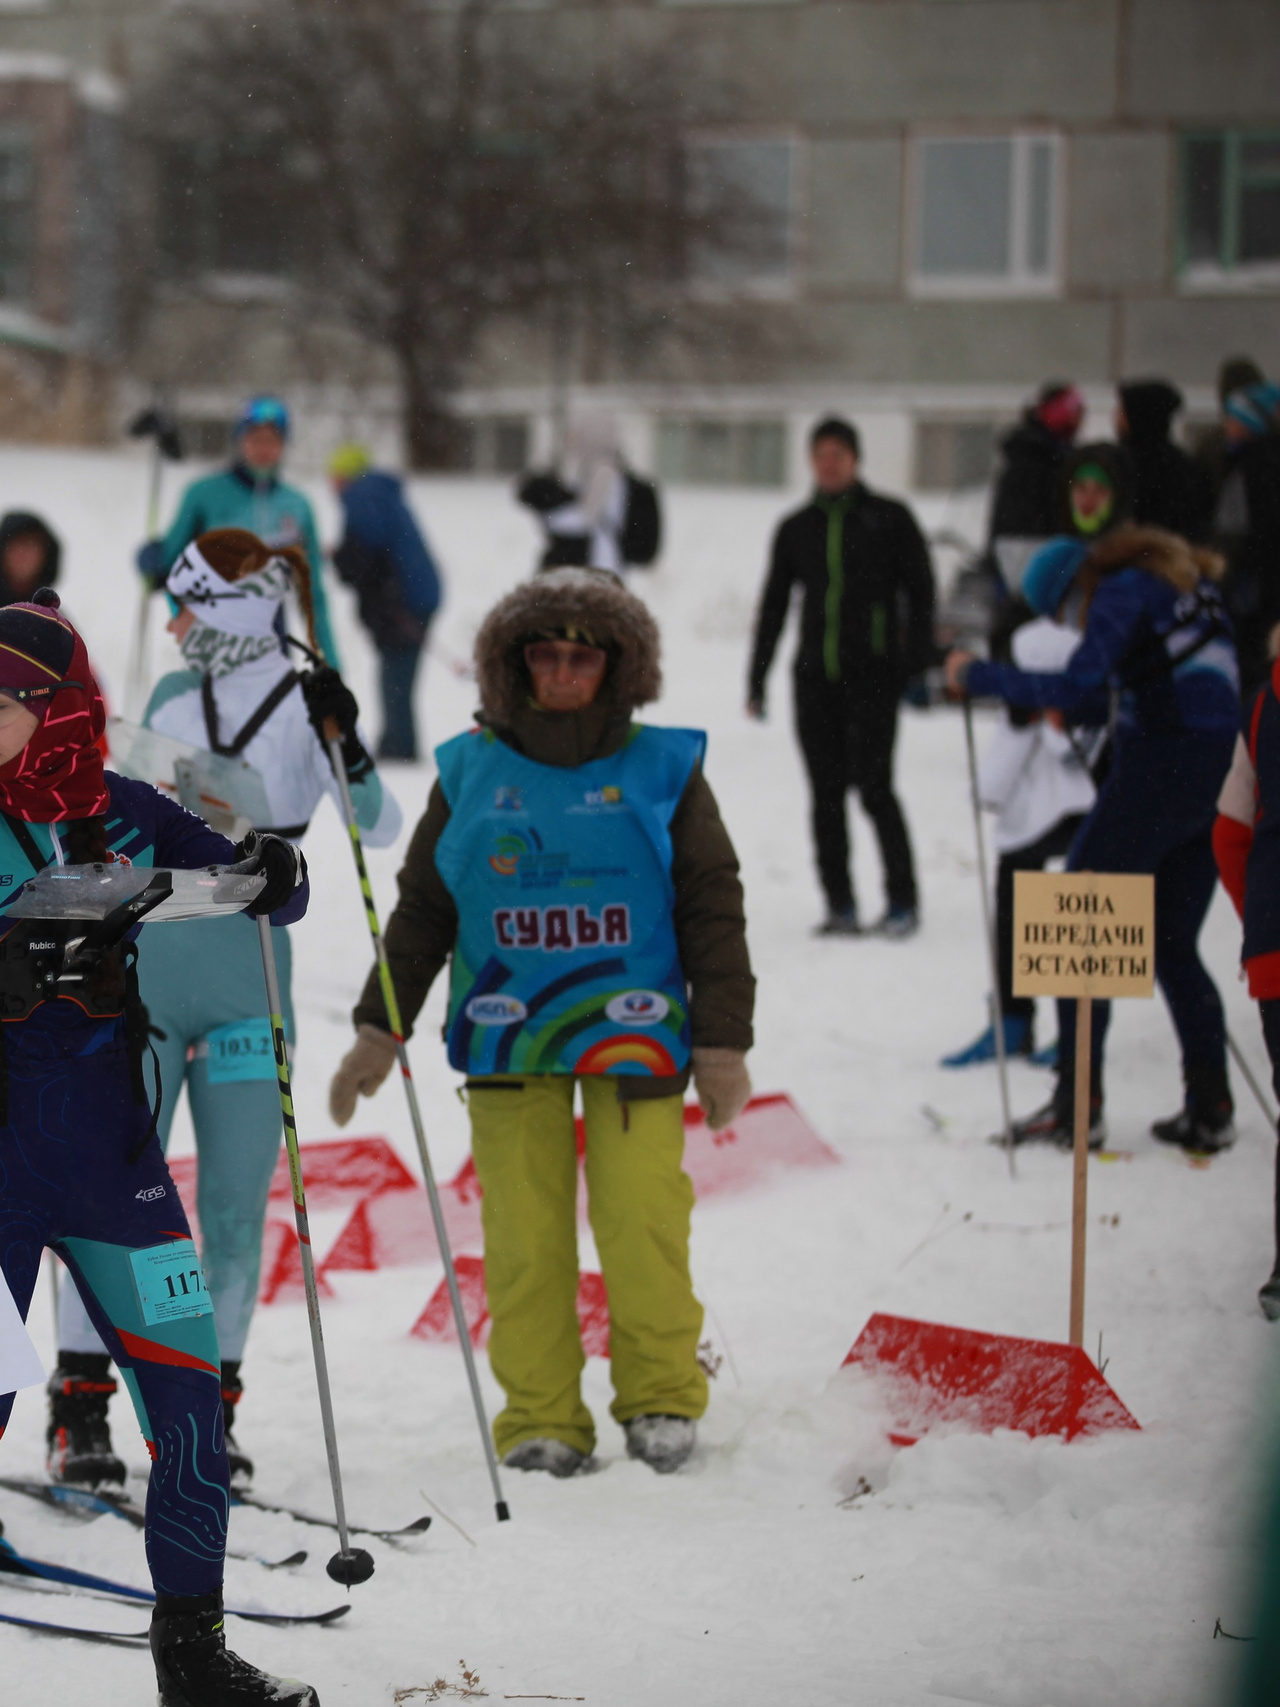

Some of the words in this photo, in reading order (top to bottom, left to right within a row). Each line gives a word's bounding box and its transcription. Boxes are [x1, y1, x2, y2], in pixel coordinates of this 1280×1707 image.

[1055, 892, 1115, 915] ЗОНА
[493, 905, 631, 950] СУДЬЯ
[1024, 923, 1145, 948] ПЕРЕДАЧИ
[1019, 953, 1148, 977] ЭСТАФЕТЫ
